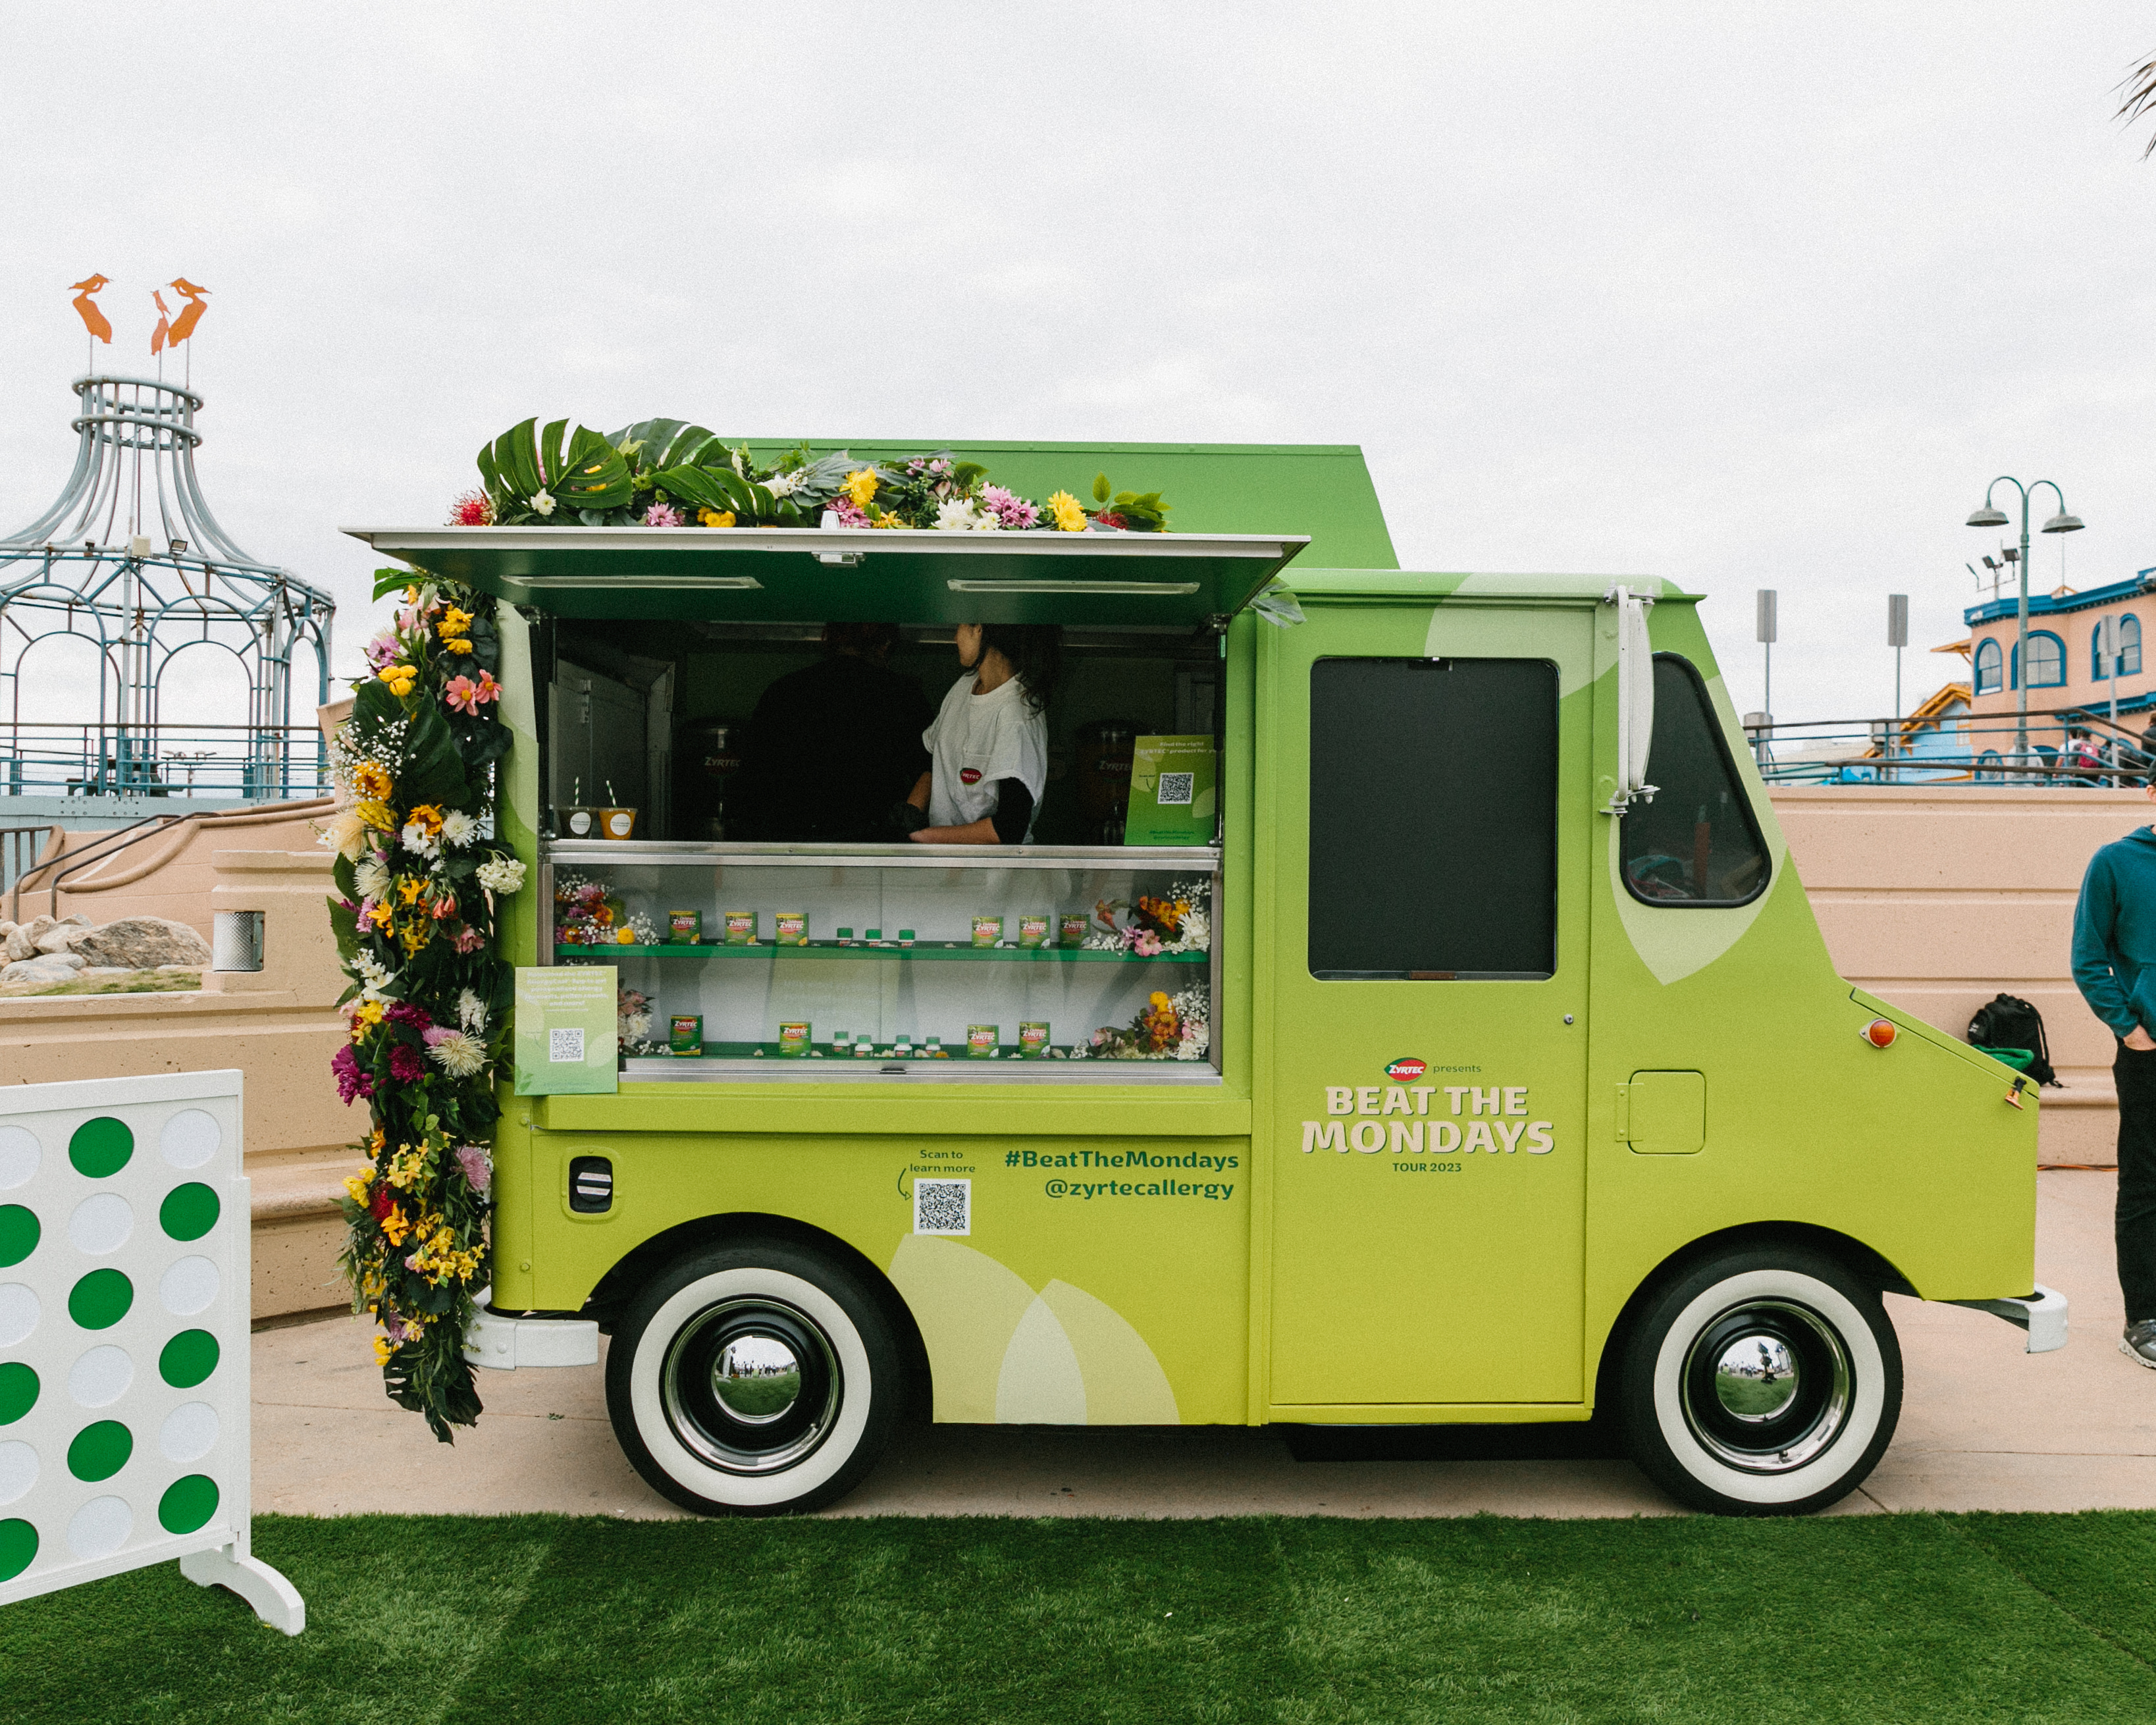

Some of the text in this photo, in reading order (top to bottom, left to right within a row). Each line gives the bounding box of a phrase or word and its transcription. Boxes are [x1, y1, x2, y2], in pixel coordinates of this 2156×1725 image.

[1099, 760, 1132, 771] ZYRTE
[1388, 1065, 1481, 1075] ZYRTEC presents
[1325, 1086, 1529, 1116] BEAT THE
[1301, 1121, 1554, 1155] MONDAYS
[920, 1150, 948, 1159] Scan
[1005, 1151, 1239, 1172] #BeatTheMondays
[910, 1163, 941, 1172] learn
[1392, 1163, 1461, 1172] TOUR 2023
[1045, 1179, 1234, 1200] @zyrtecallergy
